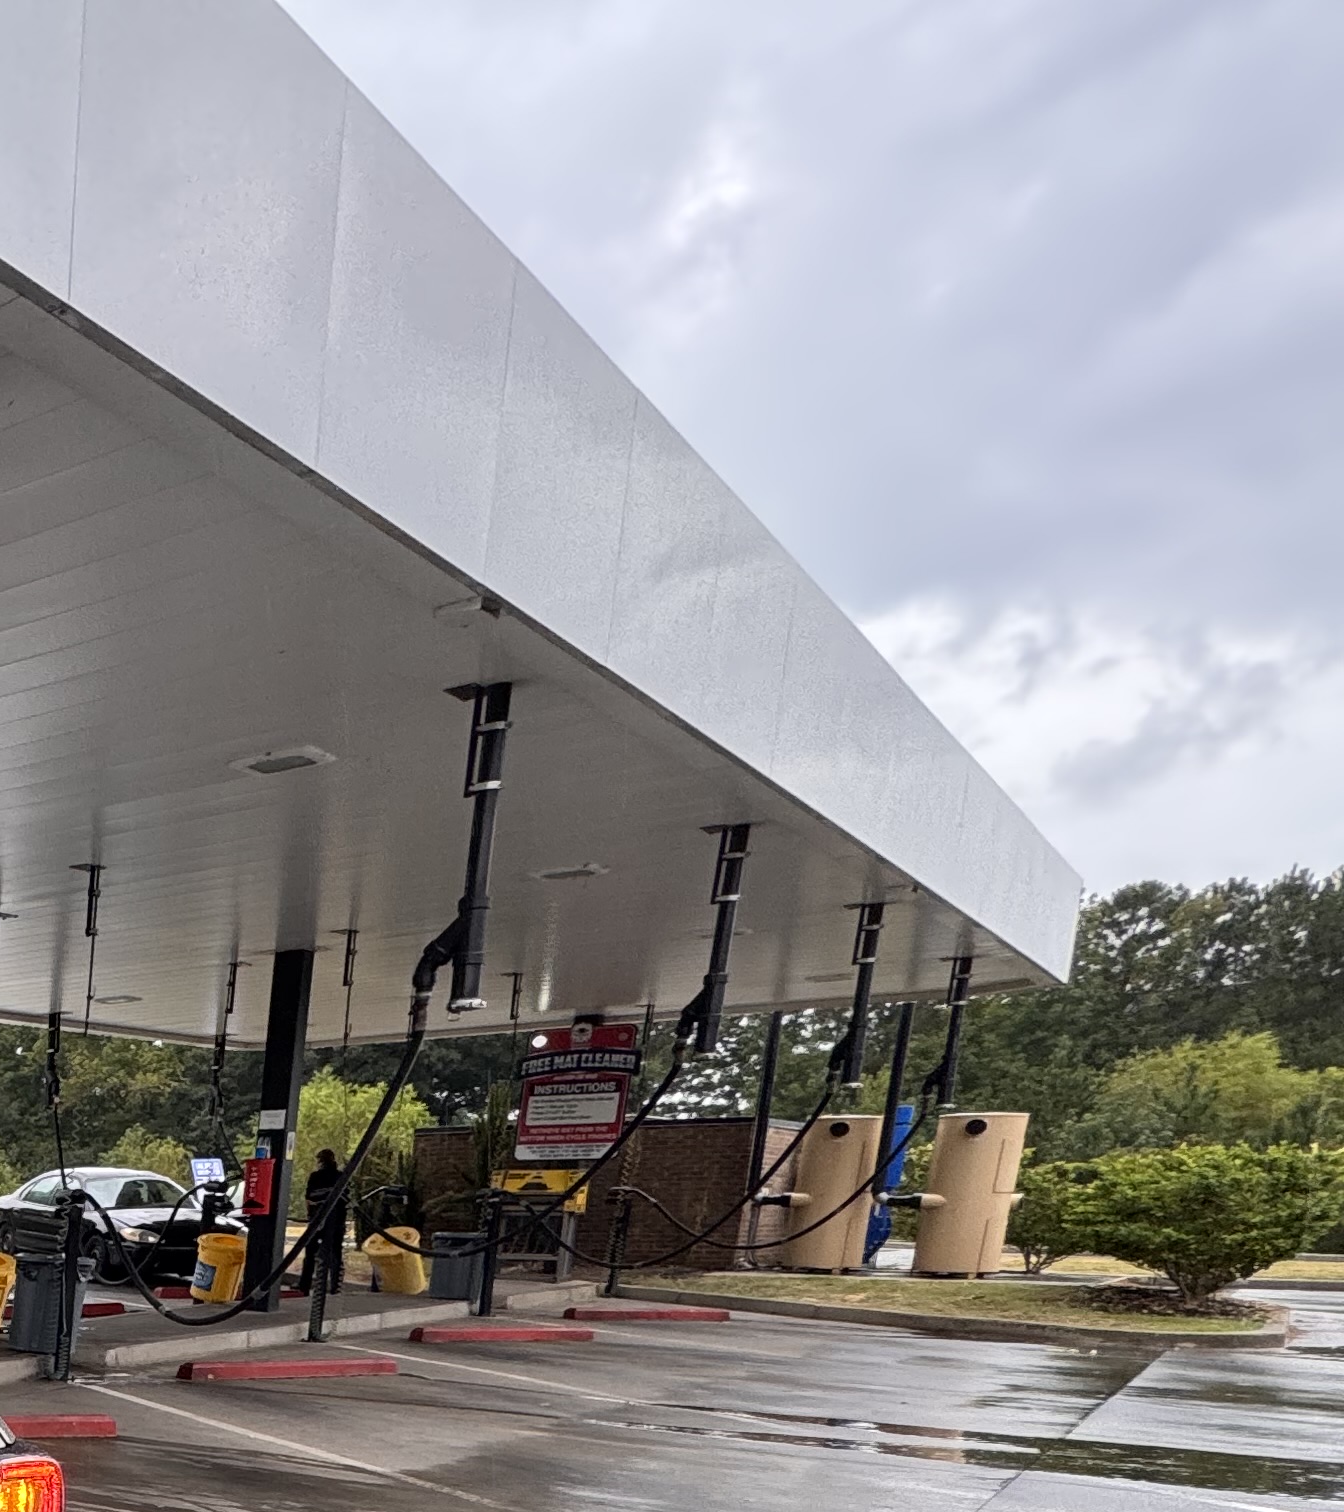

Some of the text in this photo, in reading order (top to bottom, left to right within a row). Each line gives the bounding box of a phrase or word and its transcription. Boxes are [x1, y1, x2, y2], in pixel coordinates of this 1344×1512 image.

[520, 1052, 637, 1076] FREE MAT CLEANER
[533, 1081, 617, 1095] INSTRUCTIONS
